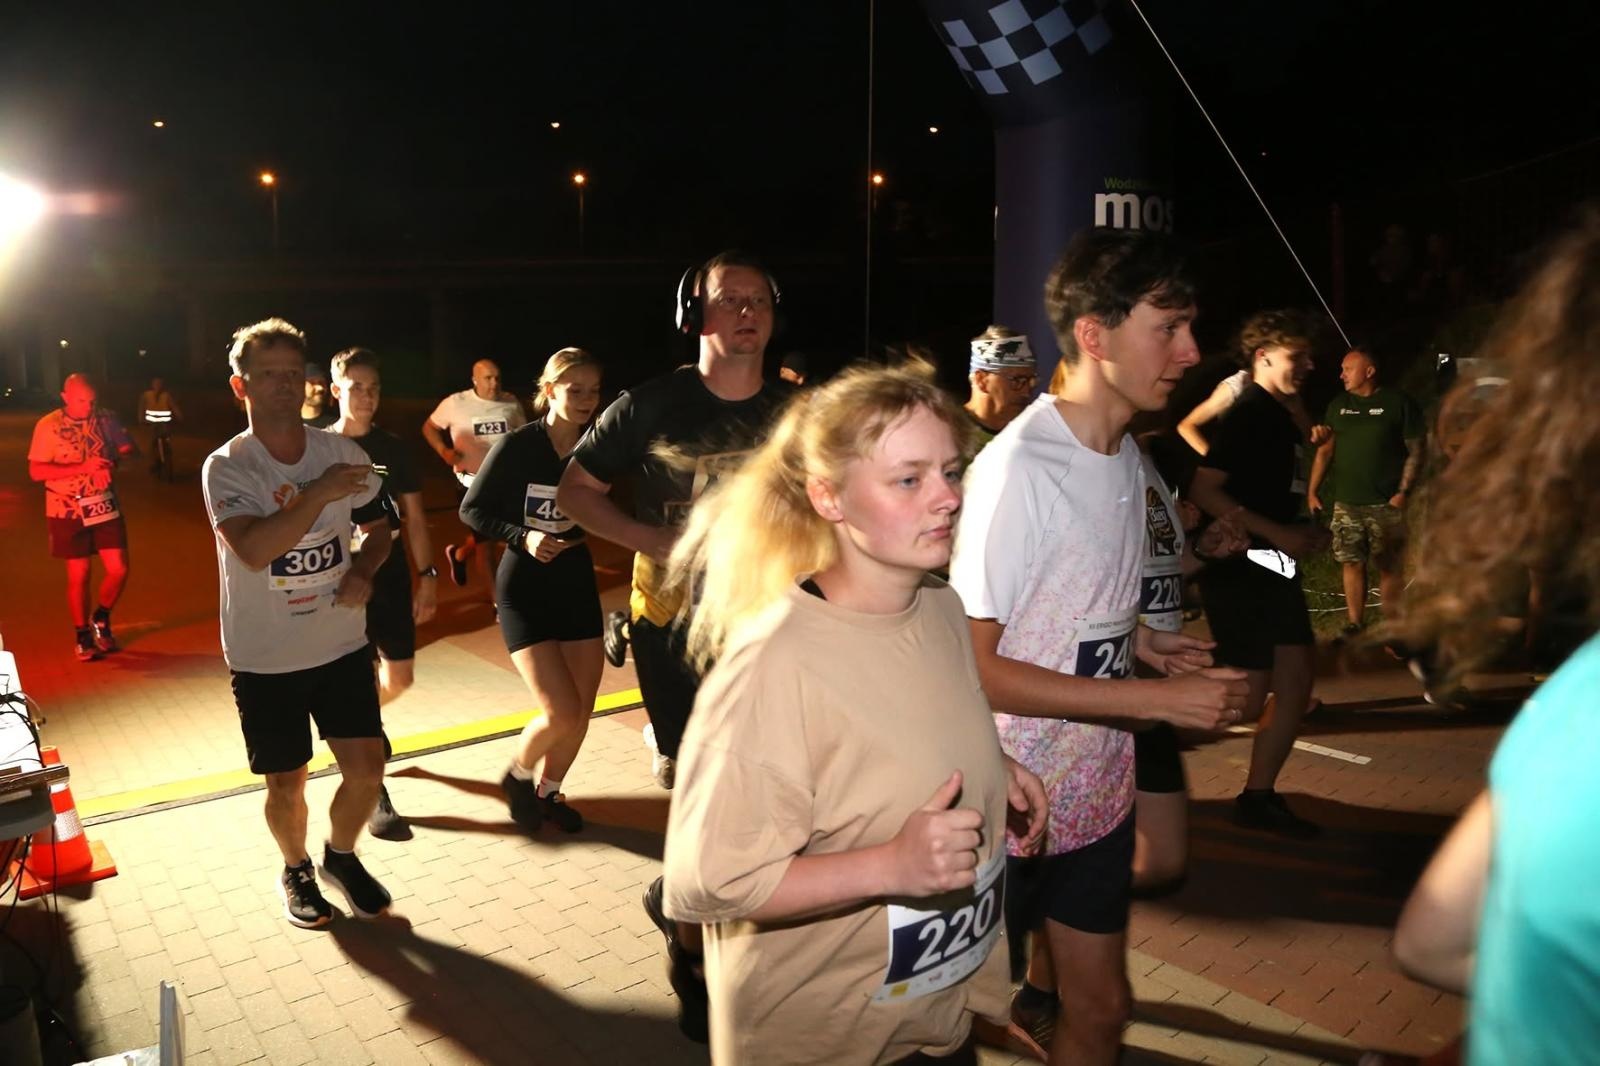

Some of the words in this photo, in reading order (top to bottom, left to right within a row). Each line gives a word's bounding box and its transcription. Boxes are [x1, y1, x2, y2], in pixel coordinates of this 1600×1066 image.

[479, 422, 502, 434] 423
[88, 501, 113, 517] 205
[536, 500, 566, 519] 46
[284, 543, 335, 574] 309
[1147, 577, 1181, 610] 228
[911, 887, 996, 973] 220
